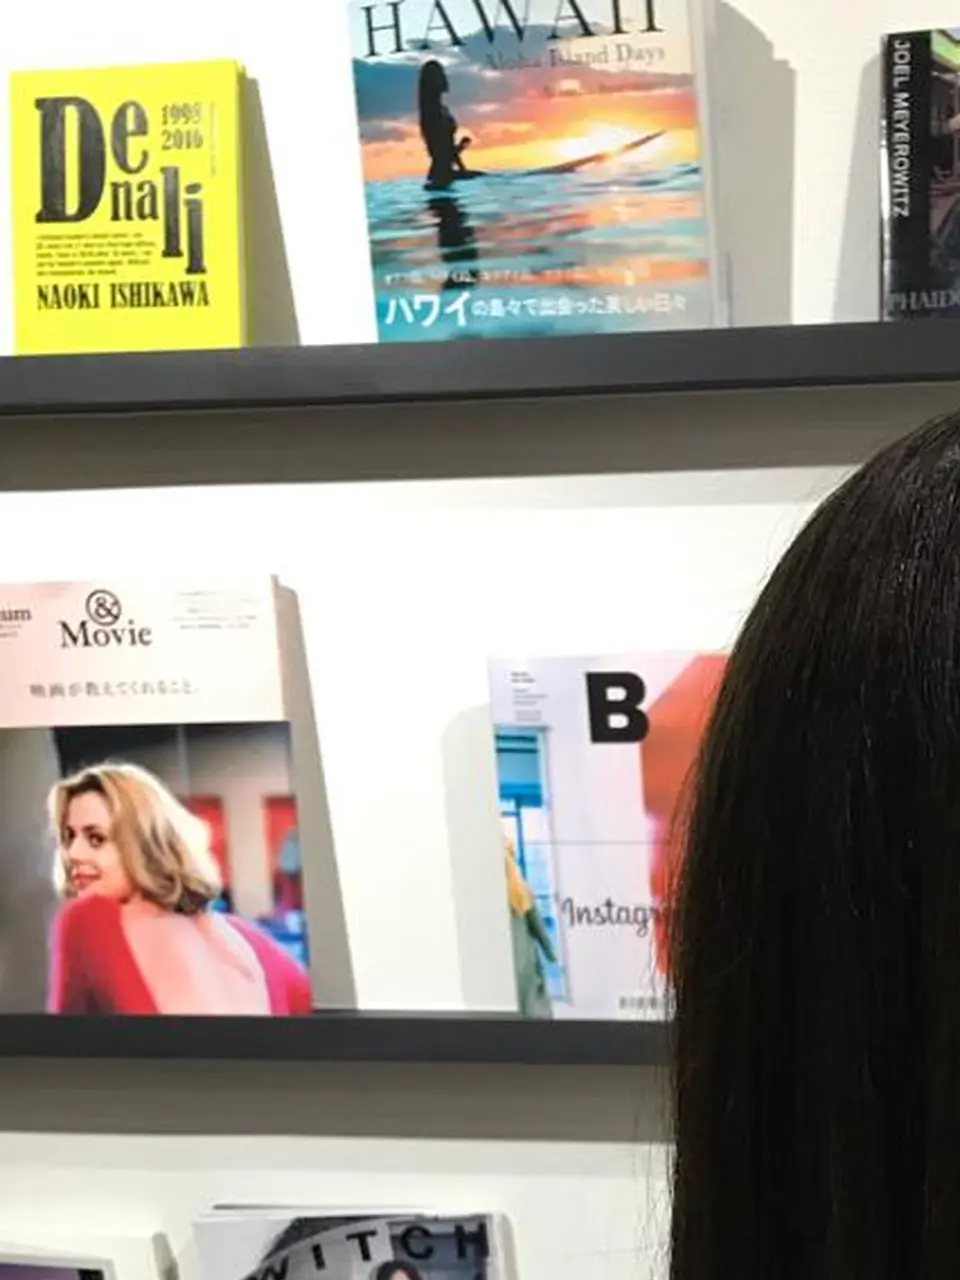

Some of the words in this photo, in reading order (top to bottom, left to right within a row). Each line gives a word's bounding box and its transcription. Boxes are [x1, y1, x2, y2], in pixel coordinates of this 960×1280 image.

[361, 0, 666, 57] HAWAII
[616, 43, 665, 63] Days
[892, 39, 911, 93] JOEL
[892, 94, 910, 217] MEYEROWITZ
[37, 282, 100, 310] NAOKI
[109, 280, 210, 309] ISHIKAWA
[59, 619, 153, 649] Movie
[585, 671, 649, 744] B
